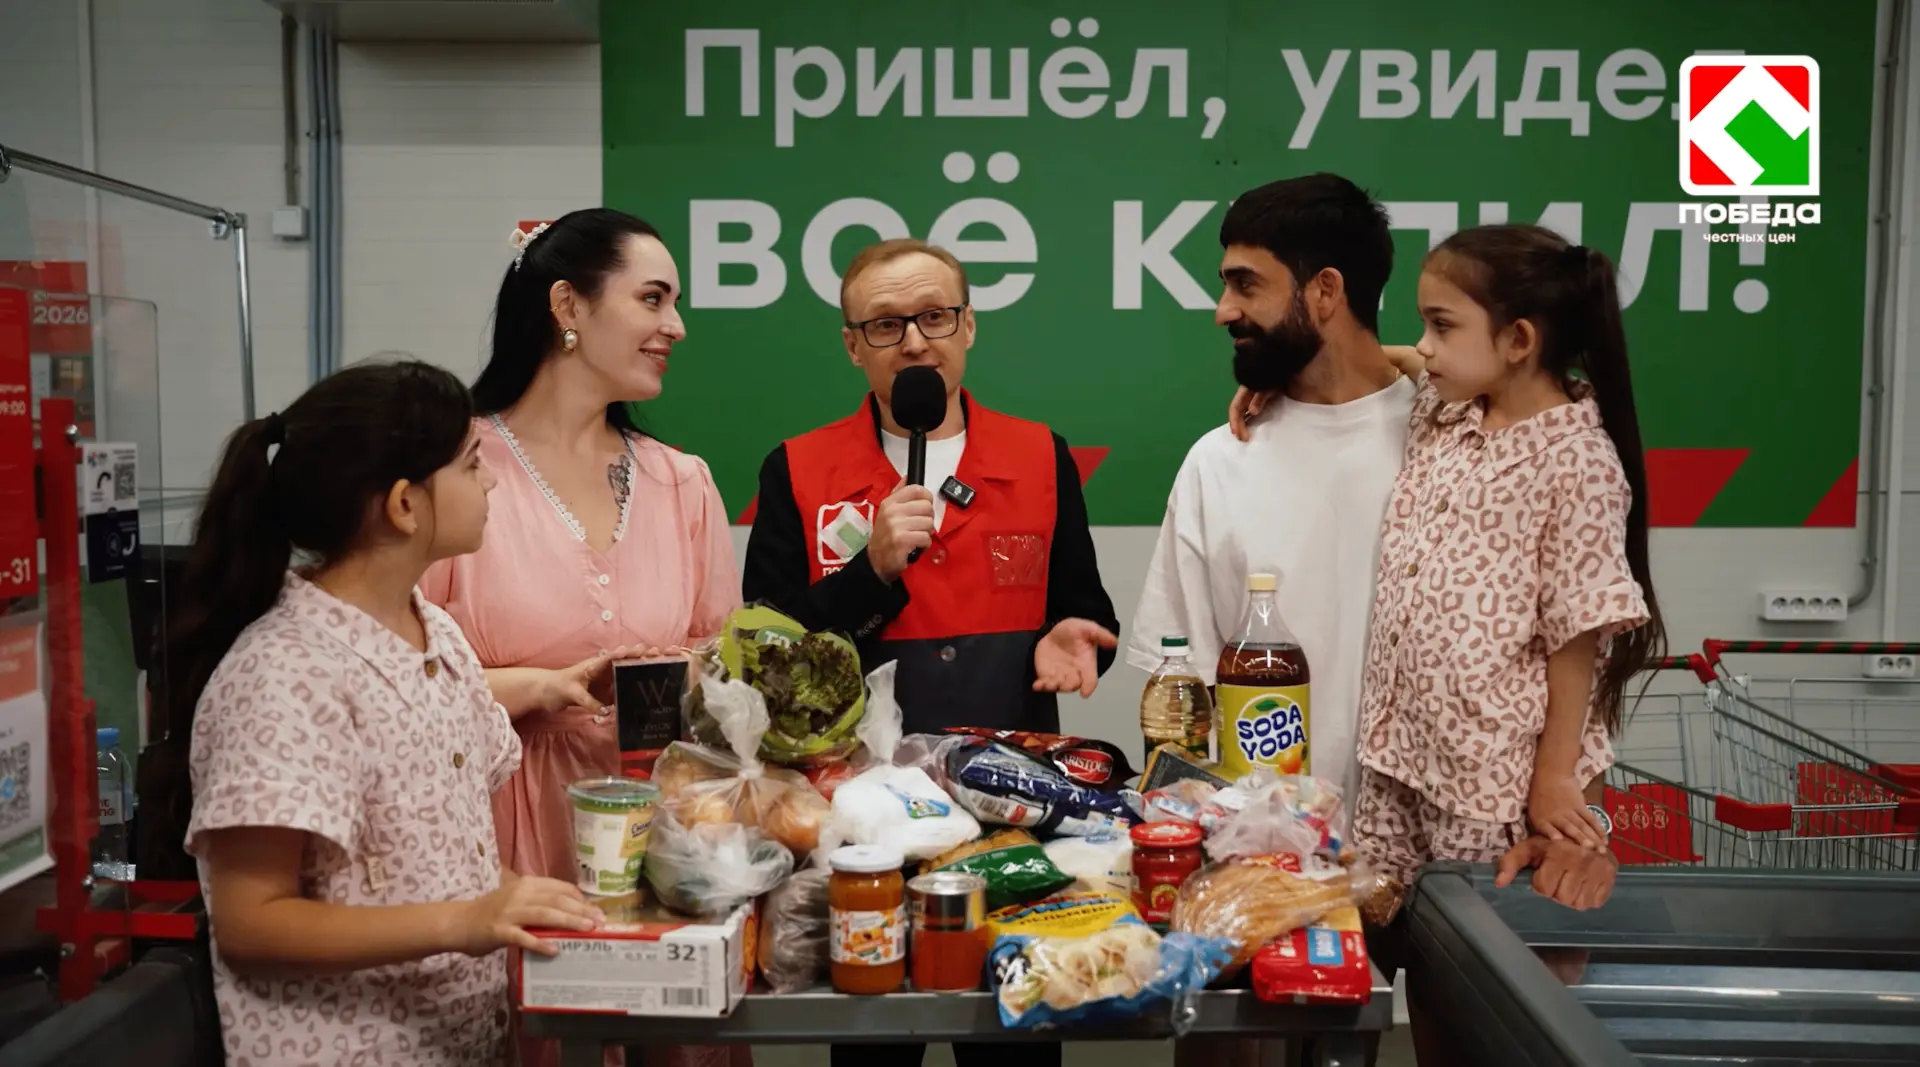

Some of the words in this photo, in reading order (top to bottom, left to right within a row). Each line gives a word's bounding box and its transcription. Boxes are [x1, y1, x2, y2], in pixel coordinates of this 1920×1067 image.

[684, 17, 1227, 148] Пришёл,
[1280, 47, 1747, 149] увиде
[32, 305, 89, 325] 2026
[1236, 703, 1303, 740] SODA
[1240, 724, 1307, 761] YODA
[665, 943, 696, 961] 32
